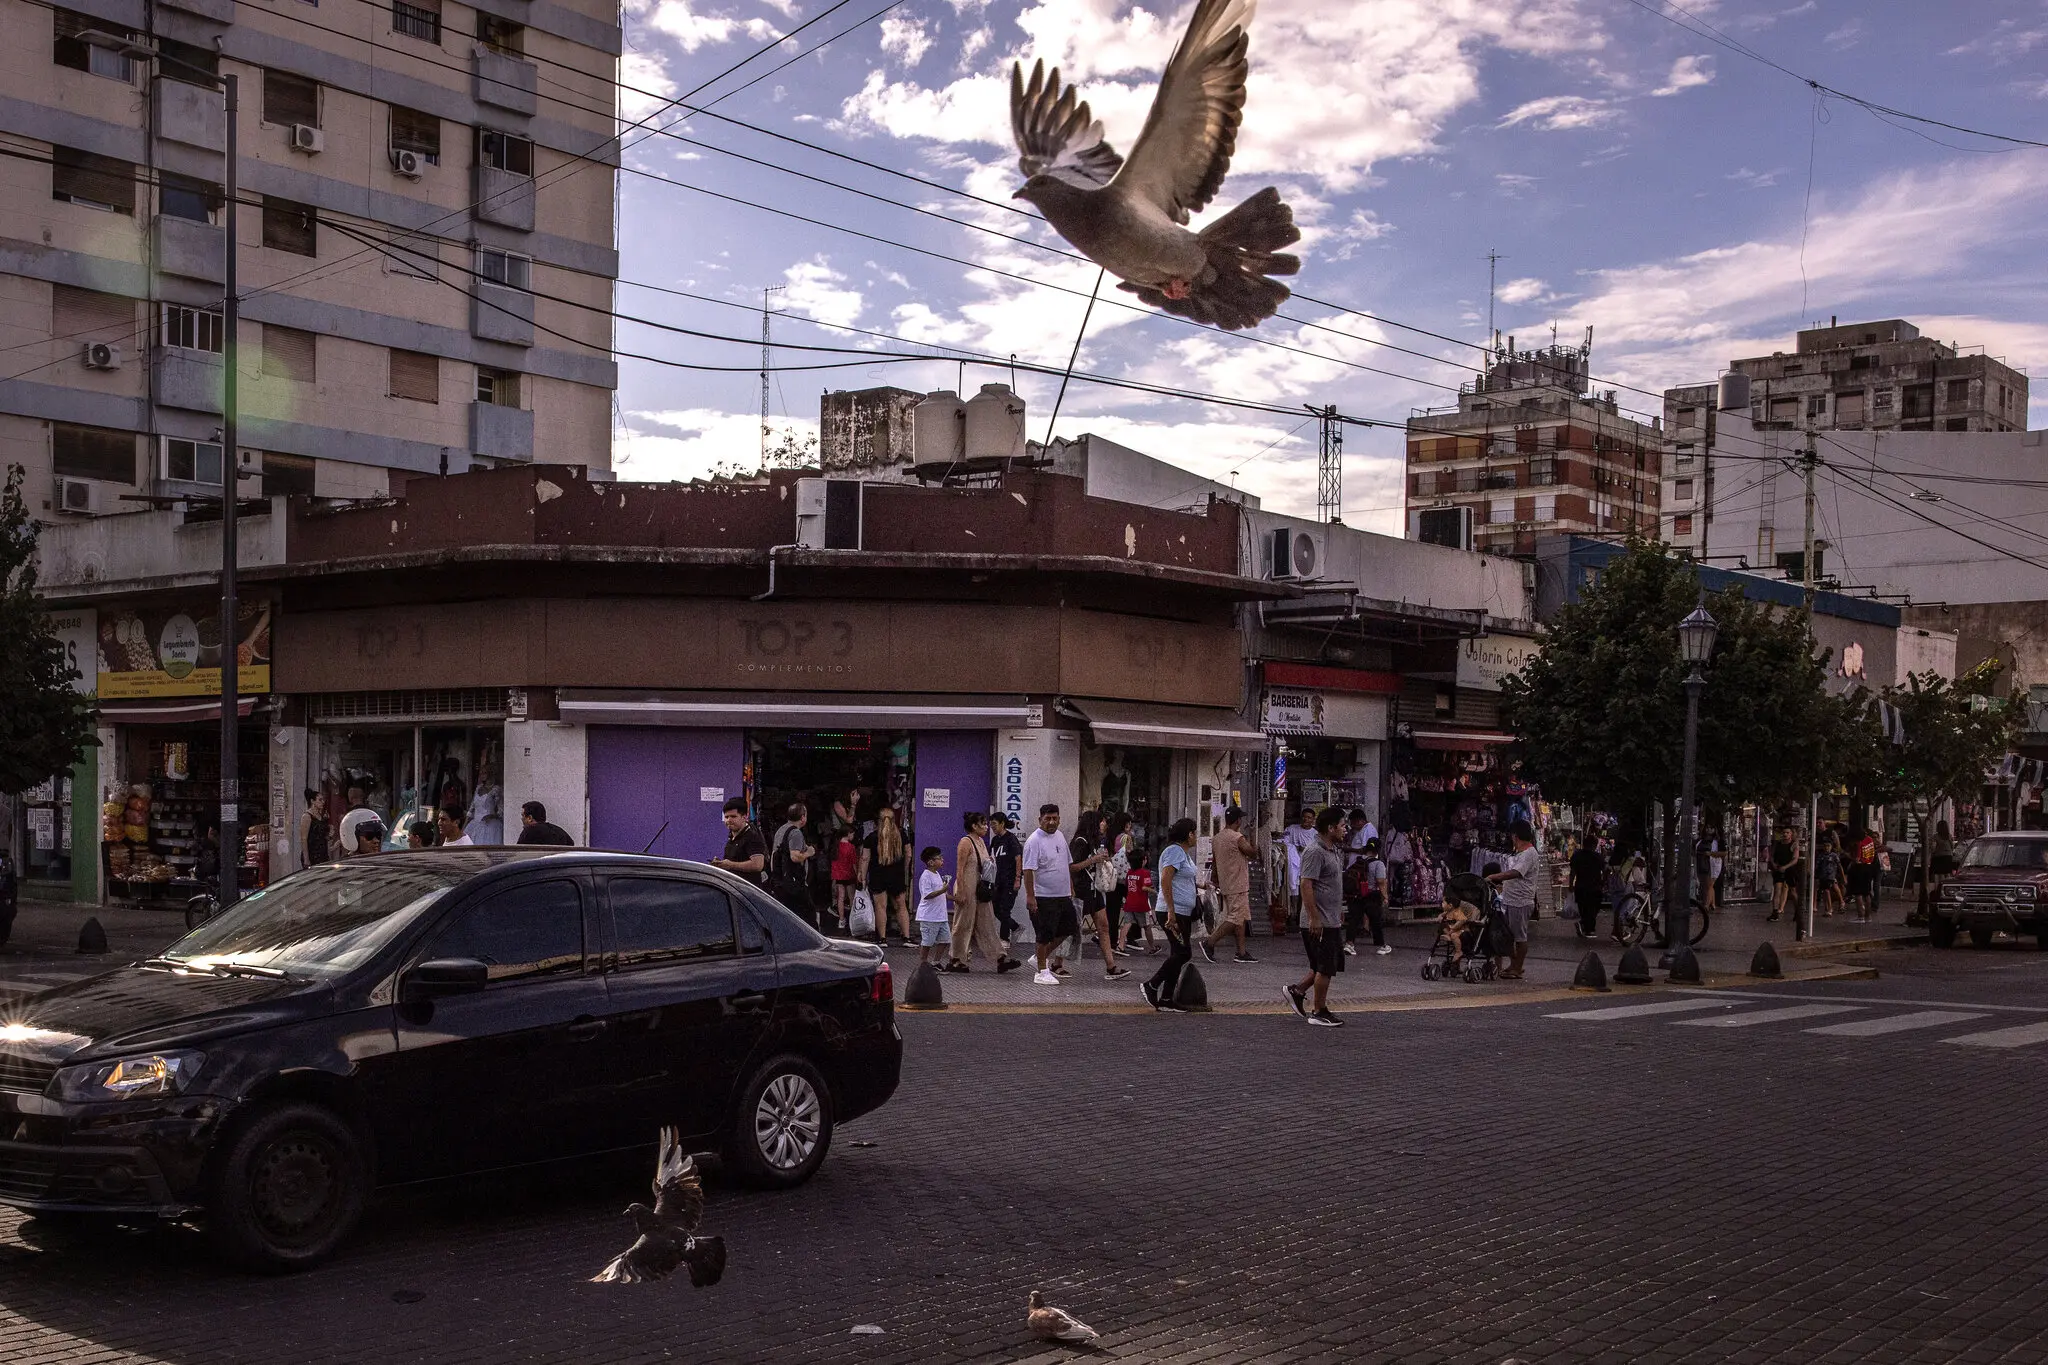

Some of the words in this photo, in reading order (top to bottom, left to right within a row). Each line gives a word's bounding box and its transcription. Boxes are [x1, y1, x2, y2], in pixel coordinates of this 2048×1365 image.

[738, 620, 815, 656] TOP
[832, 621, 854, 657] 3
[738, 664, 853, 673] COMPLEMENTOS
[1271, 694, 1309, 709] BARBERÍA
[1006, 757, 1022, 821] ABOGADA
